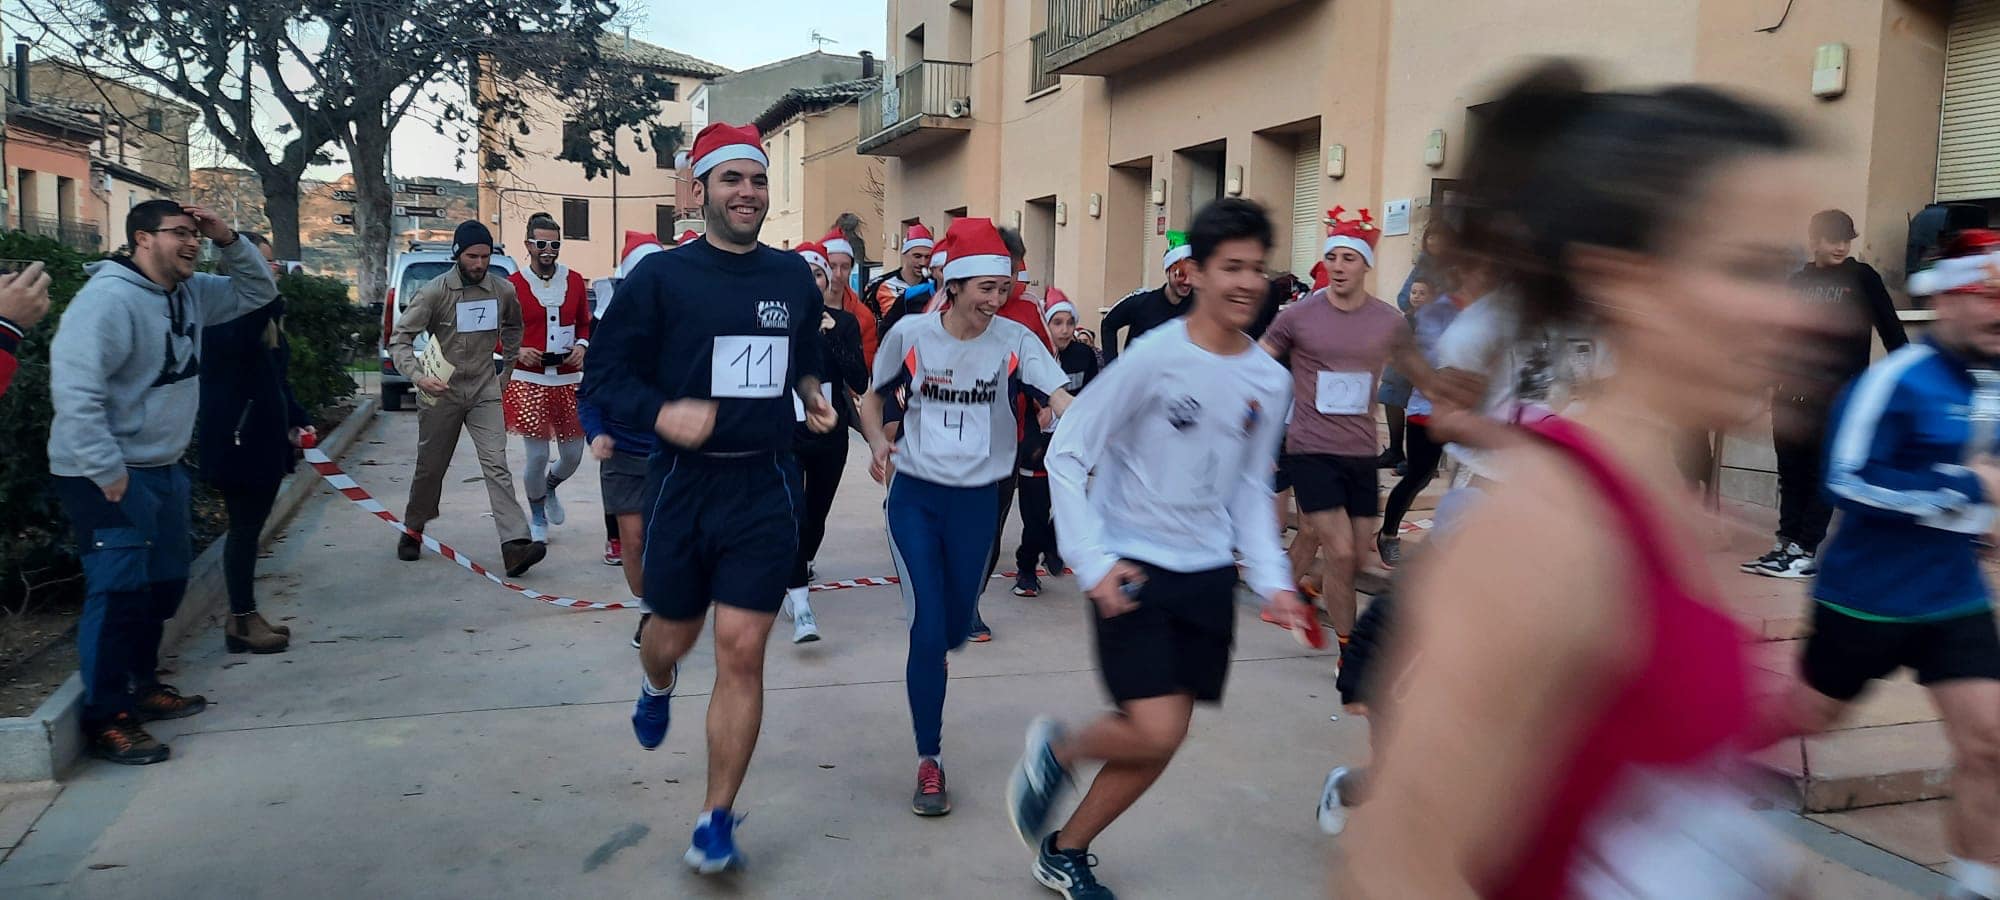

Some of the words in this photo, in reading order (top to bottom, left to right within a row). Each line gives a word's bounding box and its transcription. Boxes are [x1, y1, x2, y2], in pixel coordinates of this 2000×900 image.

[468, 307, 486, 324] 7
[731, 344, 778, 389] 11
[922, 383, 996, 405] Maratón
[943, 410, 964, 441] 4
